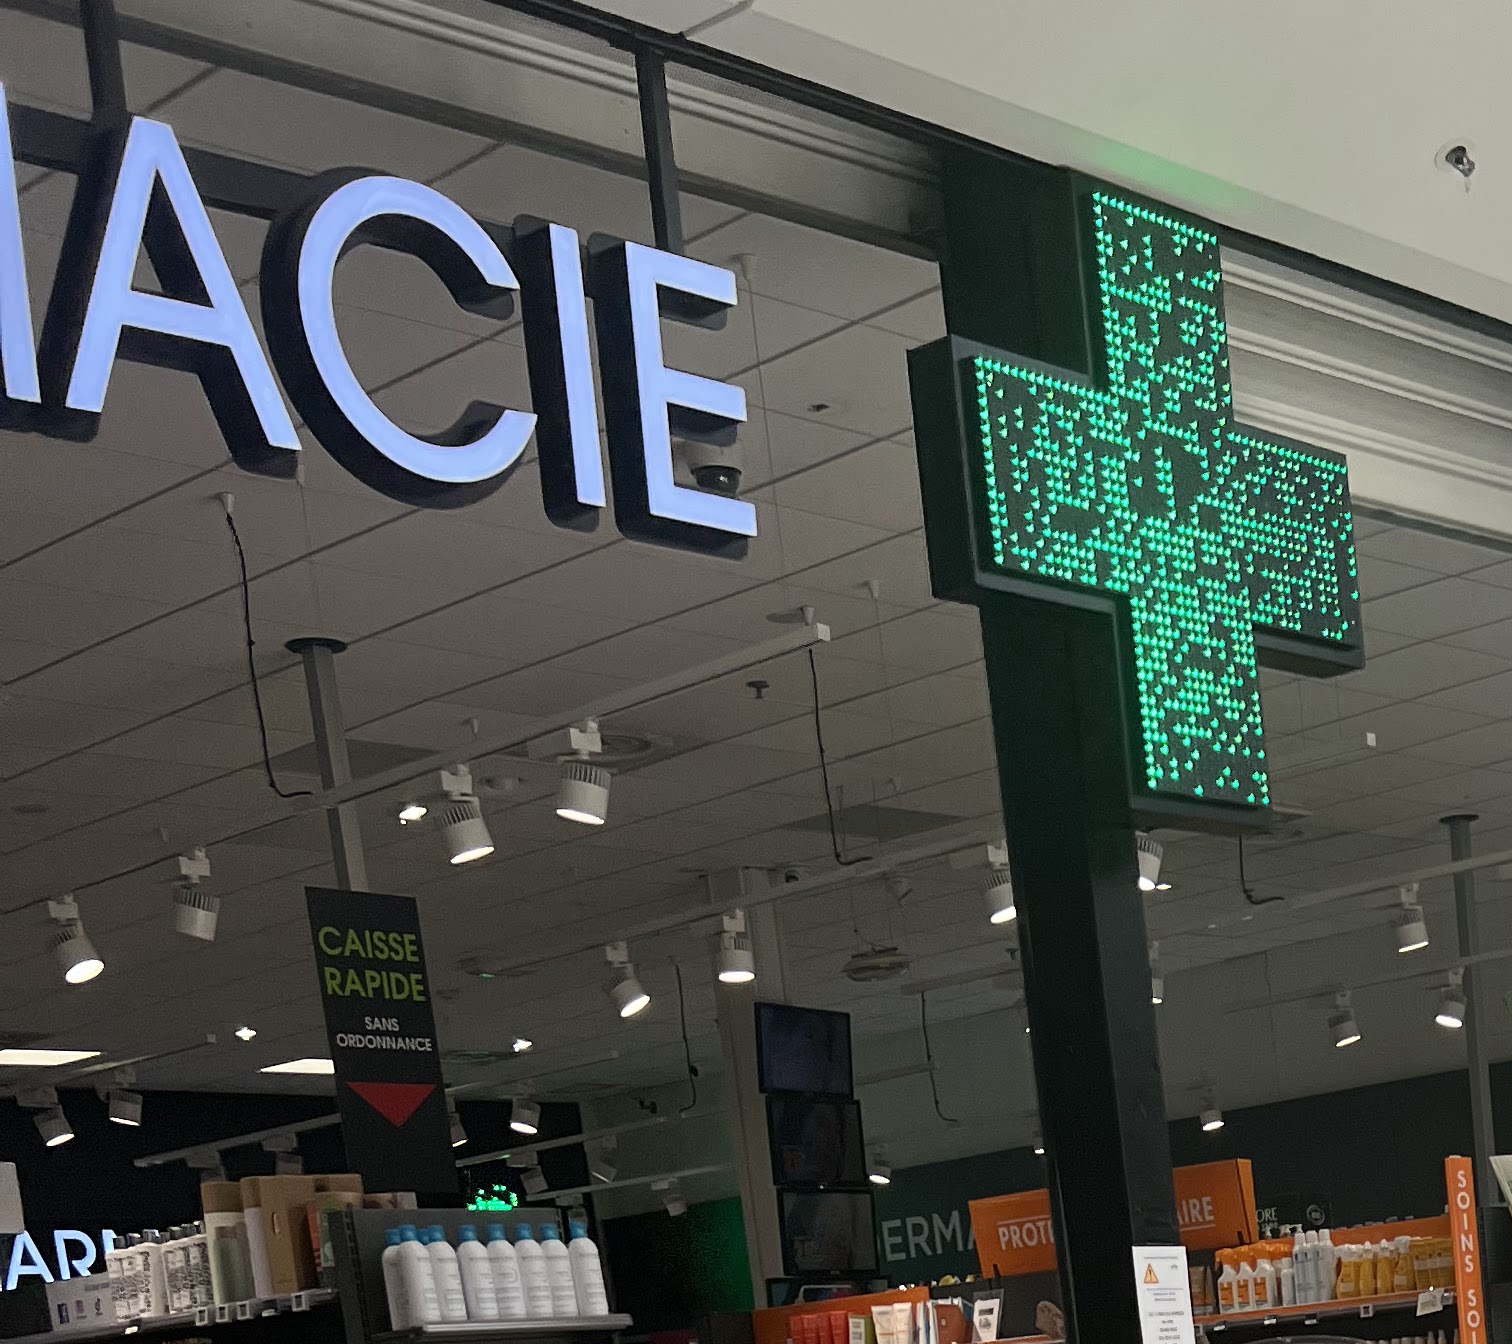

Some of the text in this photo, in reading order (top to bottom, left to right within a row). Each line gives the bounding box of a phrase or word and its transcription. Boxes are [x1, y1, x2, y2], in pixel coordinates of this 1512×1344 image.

[0, 82, 757, 538] ACIE
[318, 926, 419, 963] CAISSE
[324, 966, 427, 1002] RAPIDE
[337, 1033, 433, 1051] ORDONNANCE
[364, 1016, 400, 1031] SANS
[877, 1210, 976, 1262] ERM
[998, 1196, 1214, 1251] PROT IRE
[1456, 1170, 1475, 1273] SOINS
